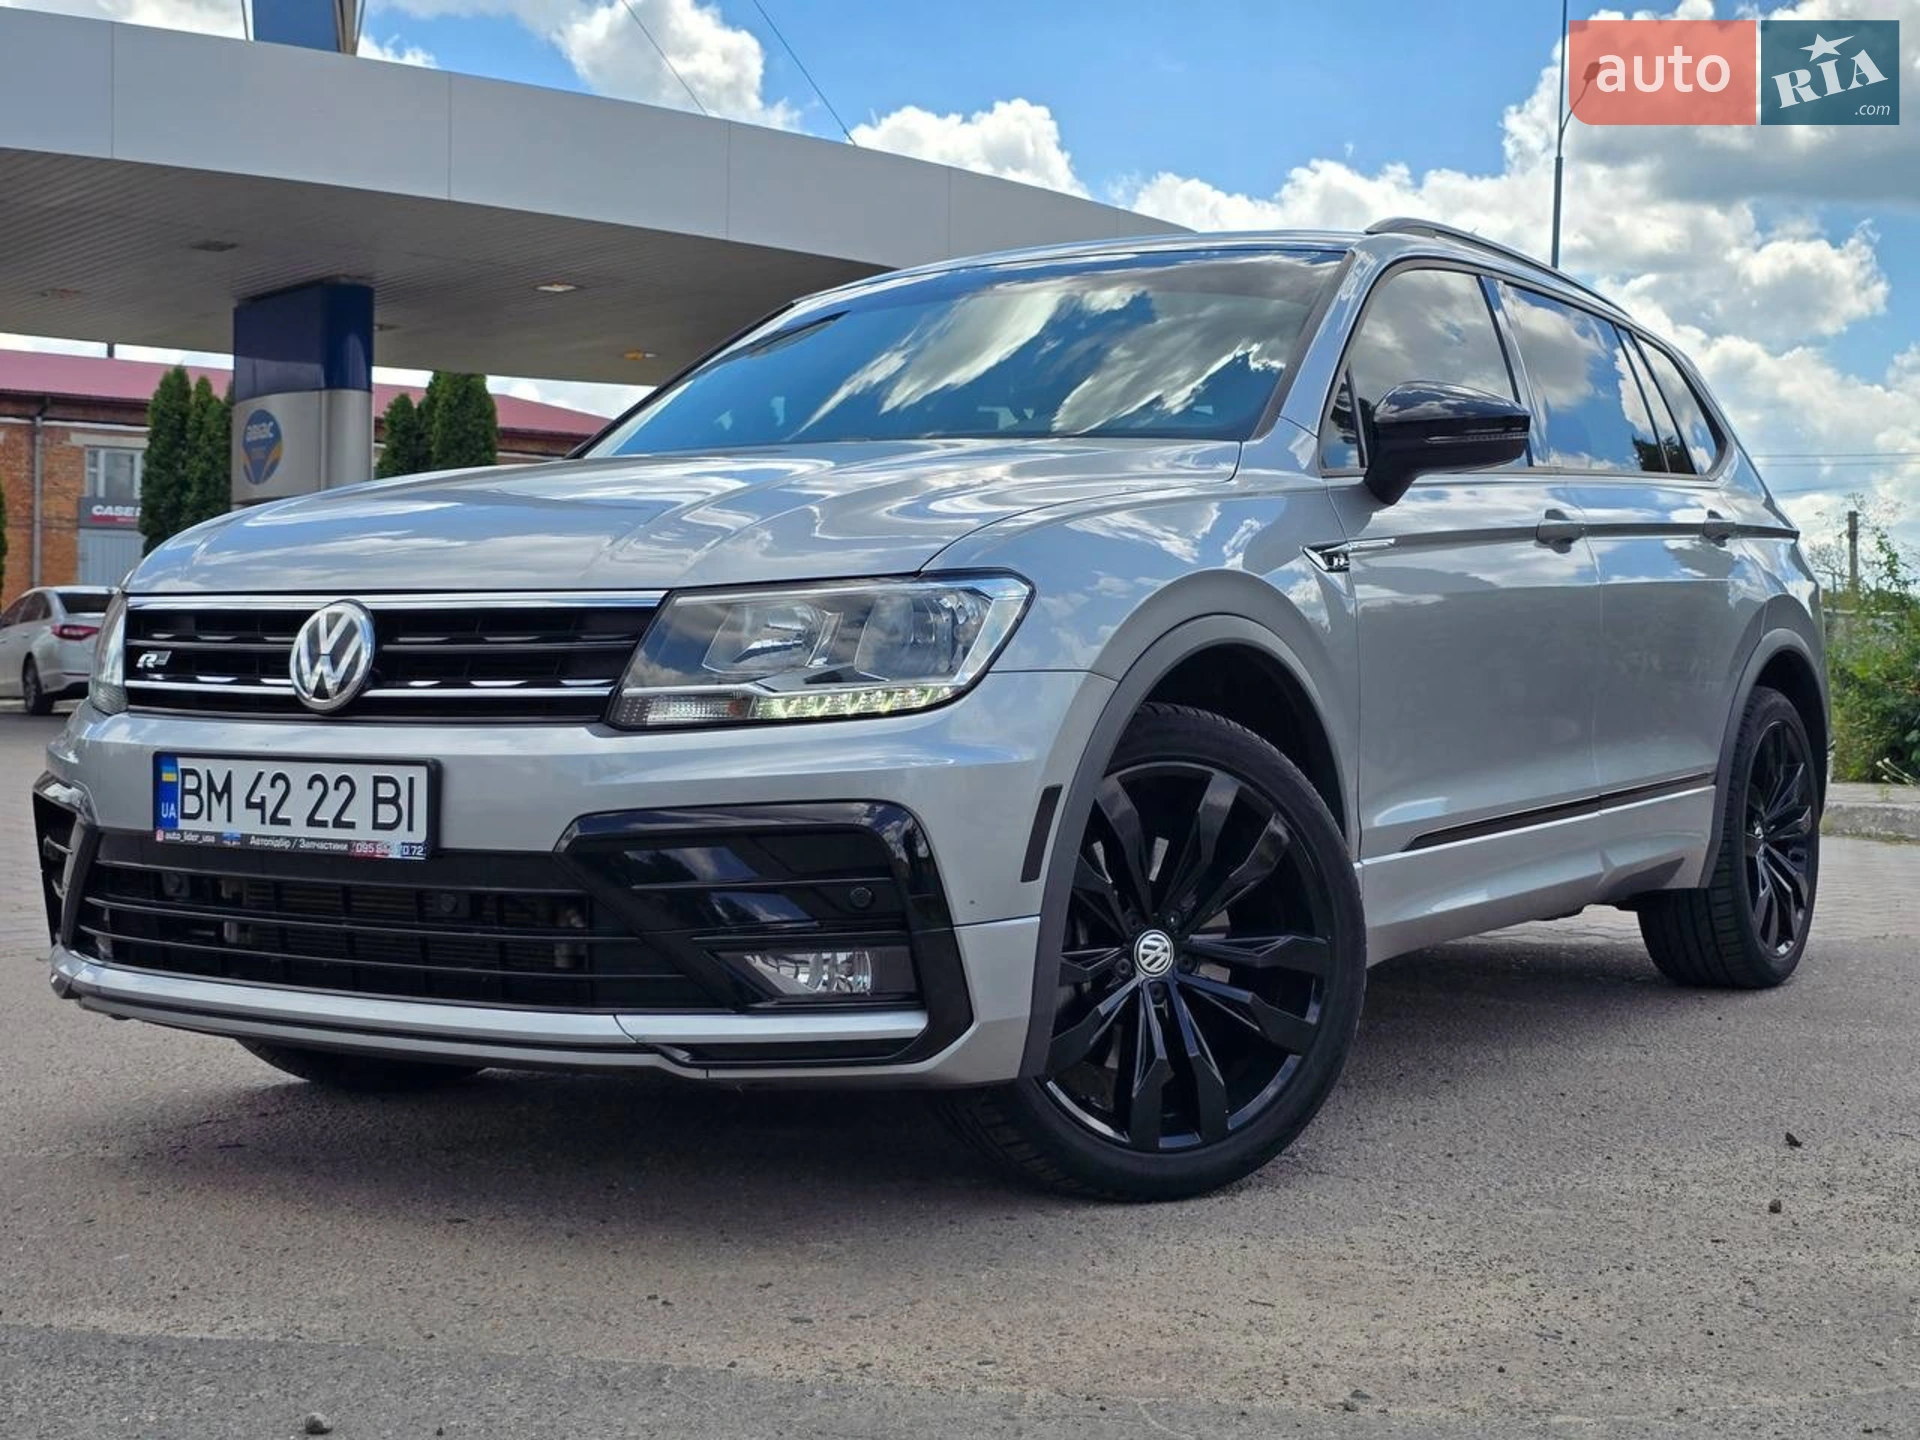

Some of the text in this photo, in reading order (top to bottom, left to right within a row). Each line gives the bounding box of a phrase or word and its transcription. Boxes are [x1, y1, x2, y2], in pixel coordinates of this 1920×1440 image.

[161, 802, 177, 819] UA
[180, 767, 415, 832] BM 42 22 BI
